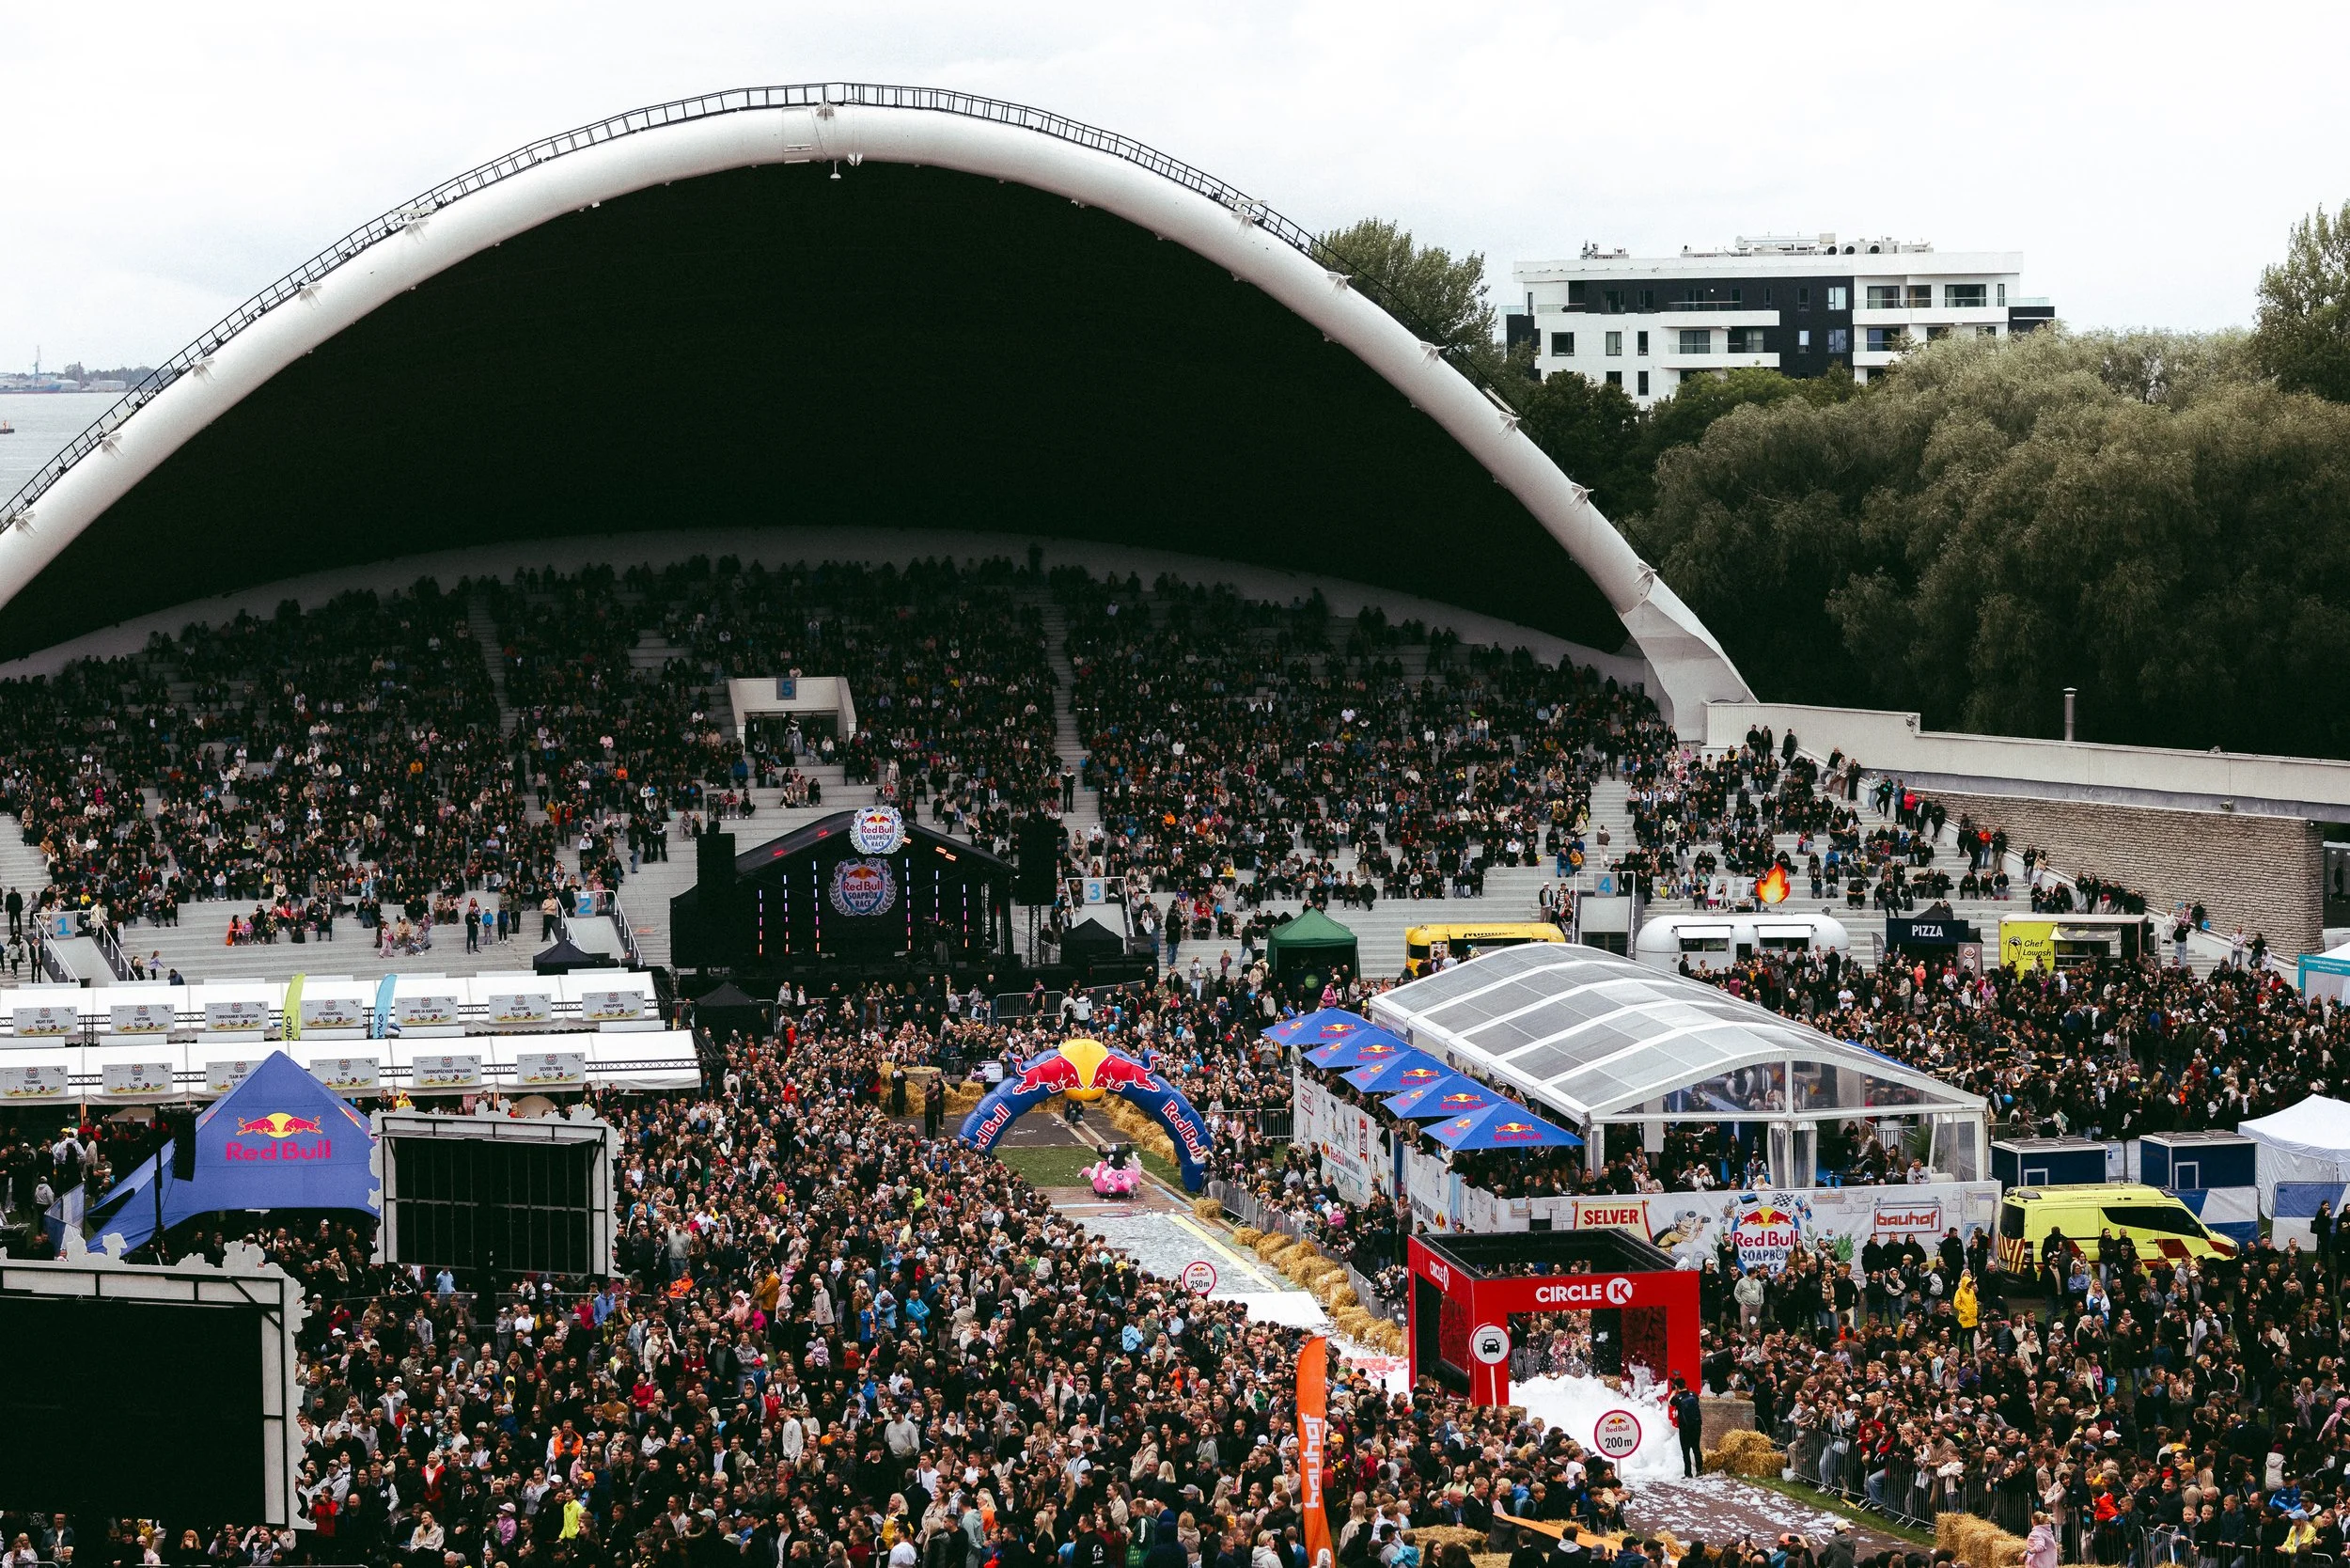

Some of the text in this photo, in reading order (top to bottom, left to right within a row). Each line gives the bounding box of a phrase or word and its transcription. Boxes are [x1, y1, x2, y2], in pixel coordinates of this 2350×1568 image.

[781, 681, 794, 697] 5
[861, 824, 895, 834] Red Bull
[842, 881, 884, 891] Red Bull
[1089, 884, 1101, 901] 3
[1598, 876, 1613, 894] 4
[579, 898, 592, 914] 2
[57, 917, 71, 935] 1
[1912, 925, 1944, 937] PIZZA
[980, 1103, 1011, 1137] Bull
[1161, 1100, 1193, 1134] Red
[226, 1139, 332, 1161] Red Bull
[1584, 1209, 1639, 1226] SELVER
[1877, 1209, 1937, 1229] bauhof
[1733, 1230, 1798, 1247] Red Bull
[1535, 1280, 1633, 1304] CIRCLE K
[1606, 1425, 1617, 1434] Red
[1605, 1436, 1633, 1449] 200 m
[1301, 1412, 1323, 1509] bauhof
